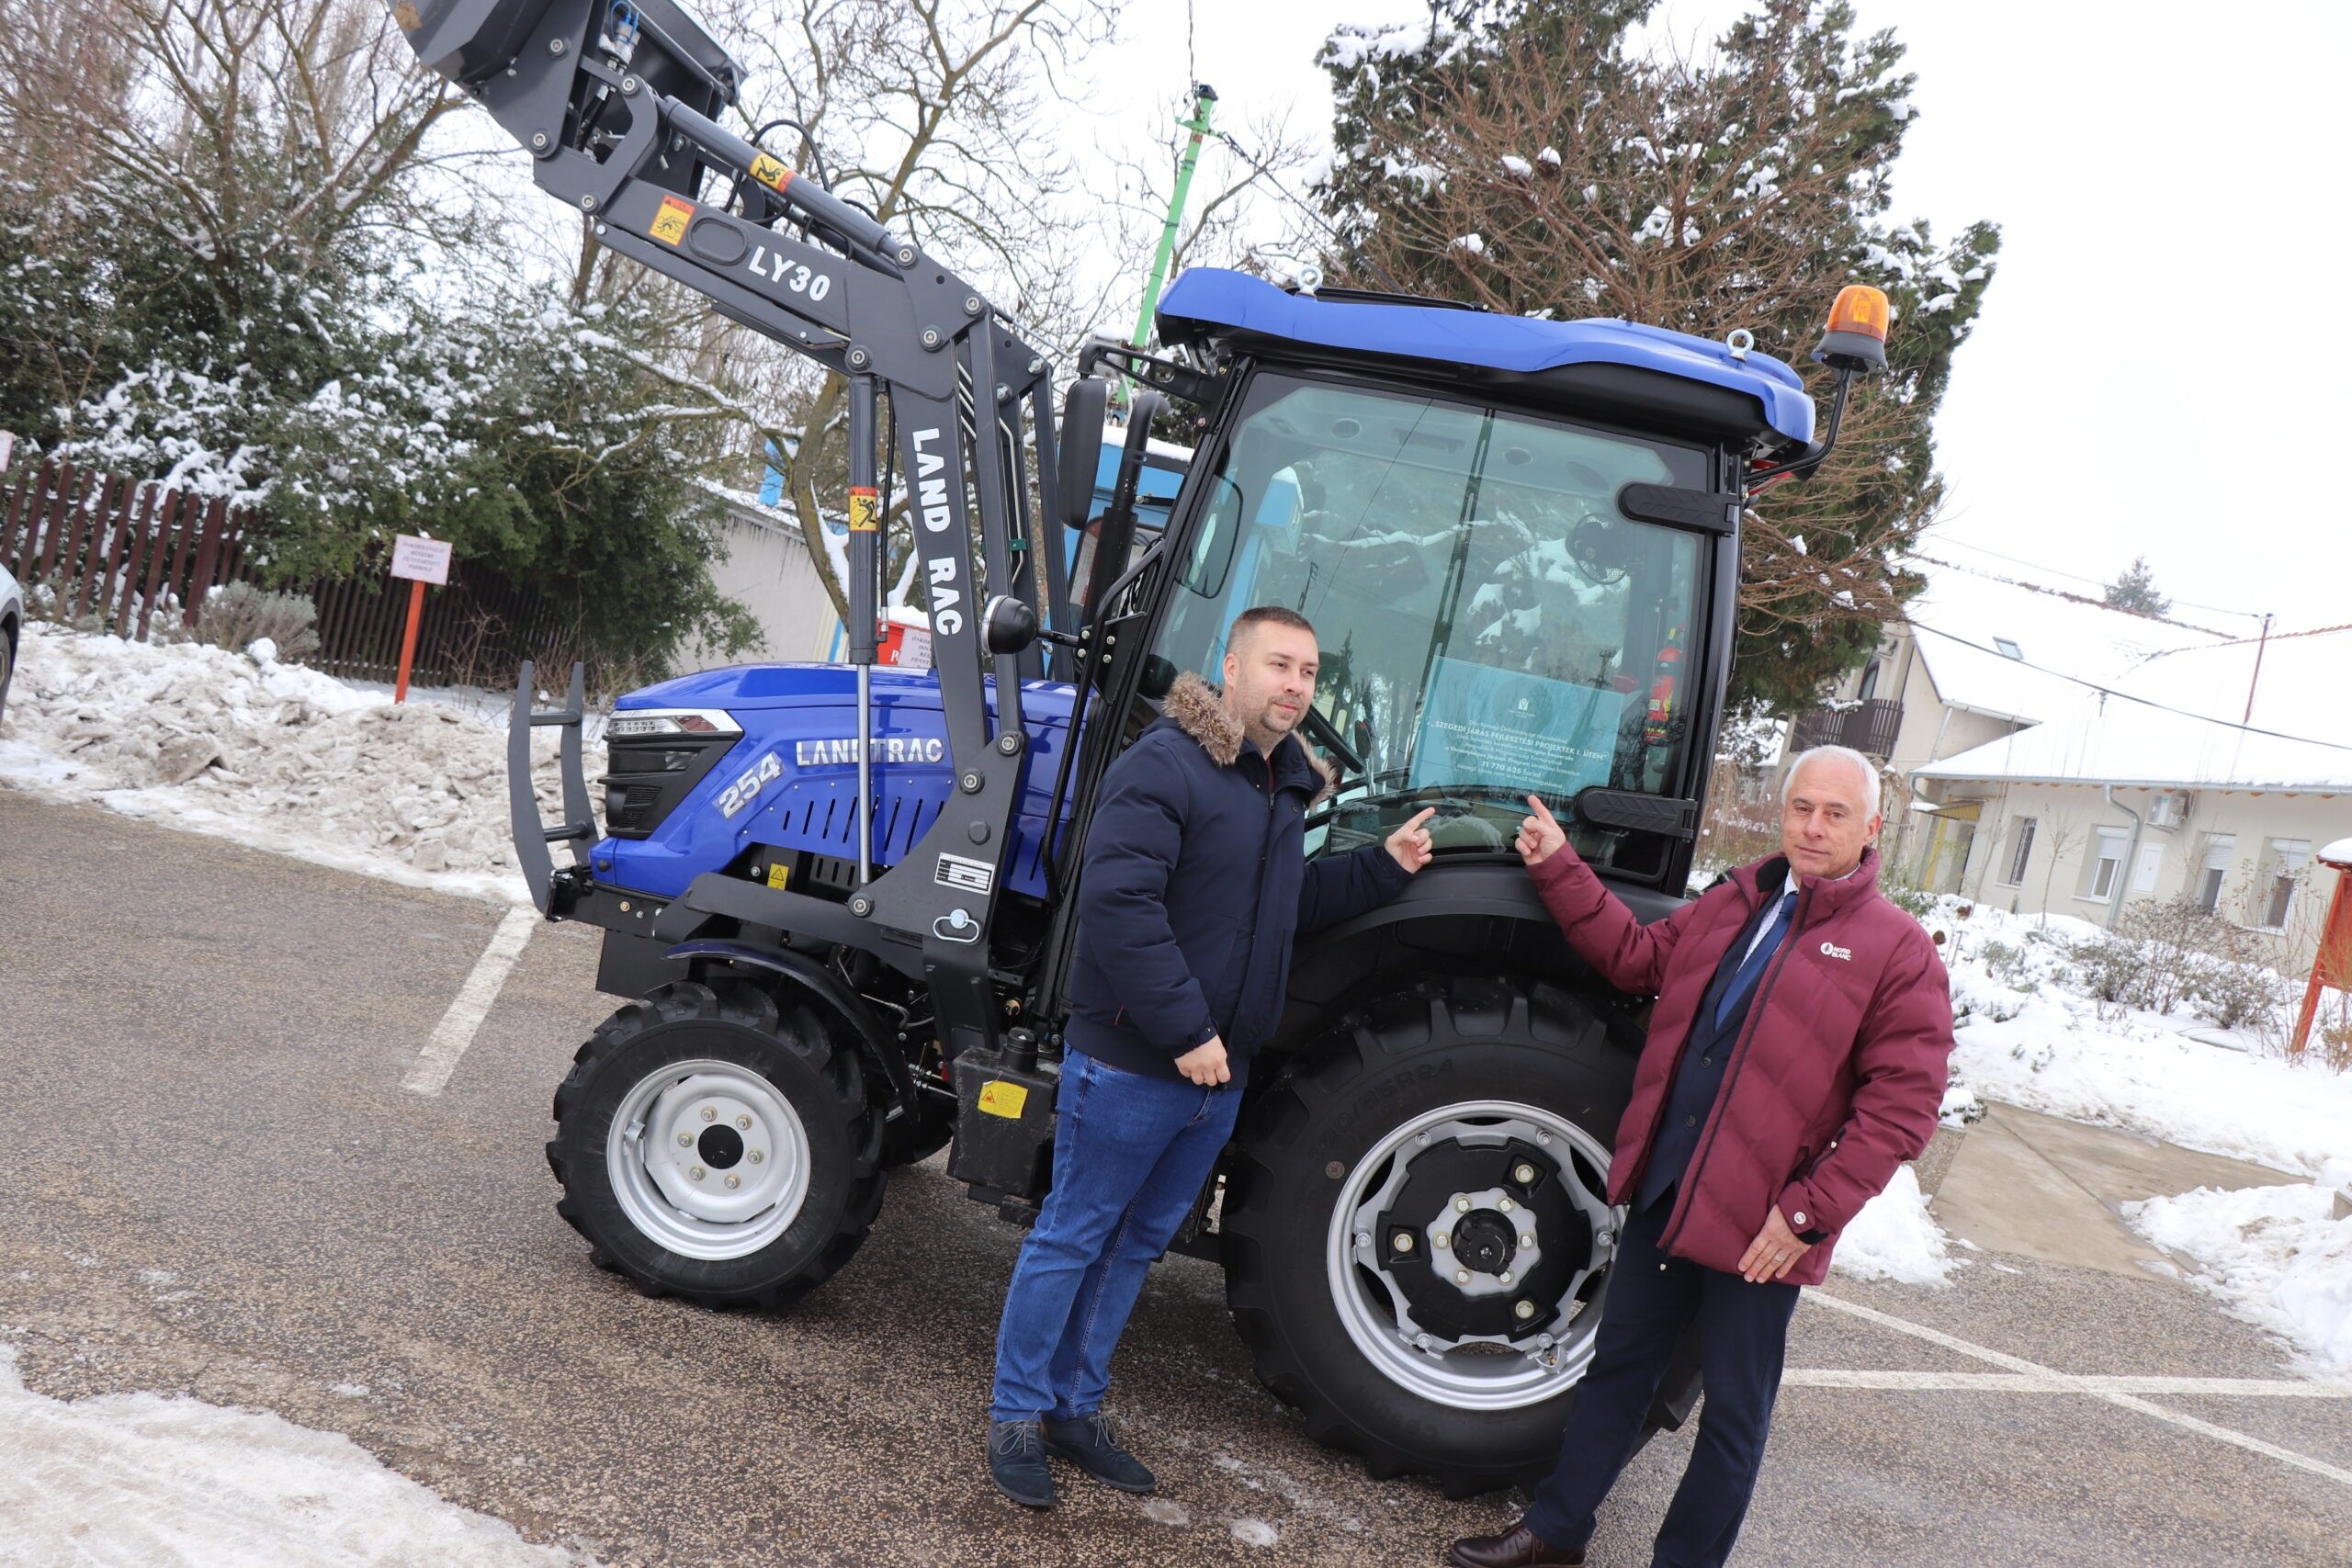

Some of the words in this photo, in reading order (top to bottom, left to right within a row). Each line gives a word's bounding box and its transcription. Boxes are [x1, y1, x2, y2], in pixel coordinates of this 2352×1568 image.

[748, 245, 831, 302] LY30
[912, 427, 951, 533] LAND
[928, 557, 963, 636] RAC
[1490, 761, 1505, 771] 770
[1506, 765, 1521, 773] 625
[1534, 740, 1575, 754] PROJEKTEK
[718, 751, 783, 818] 254
